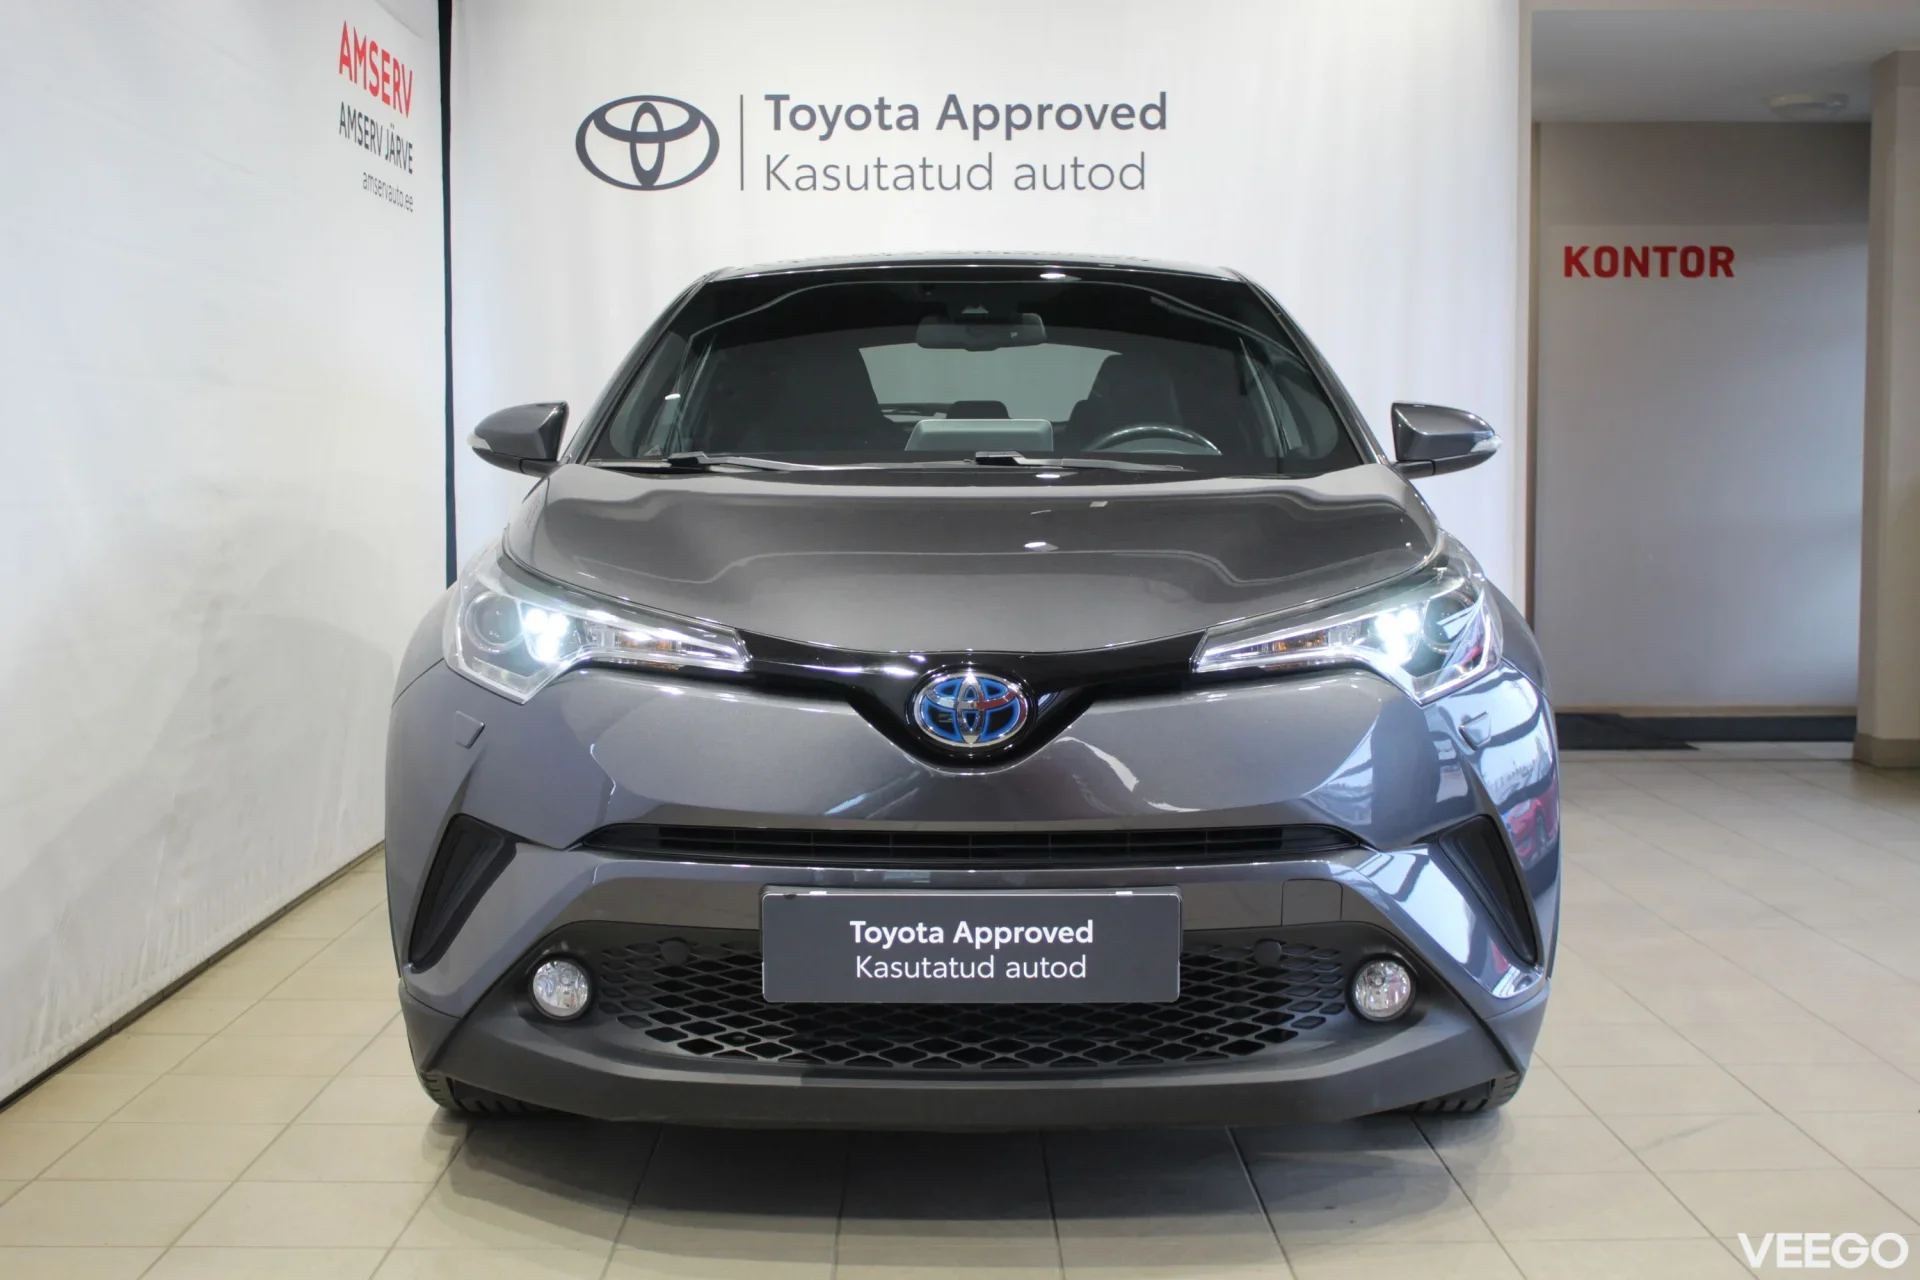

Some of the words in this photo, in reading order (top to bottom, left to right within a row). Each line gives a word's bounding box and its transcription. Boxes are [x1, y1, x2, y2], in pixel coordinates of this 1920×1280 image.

[339, 20, 413, 118] AMSERV
[764, 94, 920, 142] Toyota
[936, 91, 1168, 141] Approved
[339, 101, 383, 157] AMSERV
[385, 123, 413, 174] JÄRVE
[765, 153, 994, 192] Kasutatud
[1013, 152, 1146, 192] autod
[362, 172, 414, 213] amservauto.ee
[1563, 246, 1735, 278] KONTOR
[849, 920, 944, 949] Toyota
[953, 919, 1095, 949] Approved
[855, 955, 995, 979] Kasutatud
[1005, 954, 1087, 979] autod
